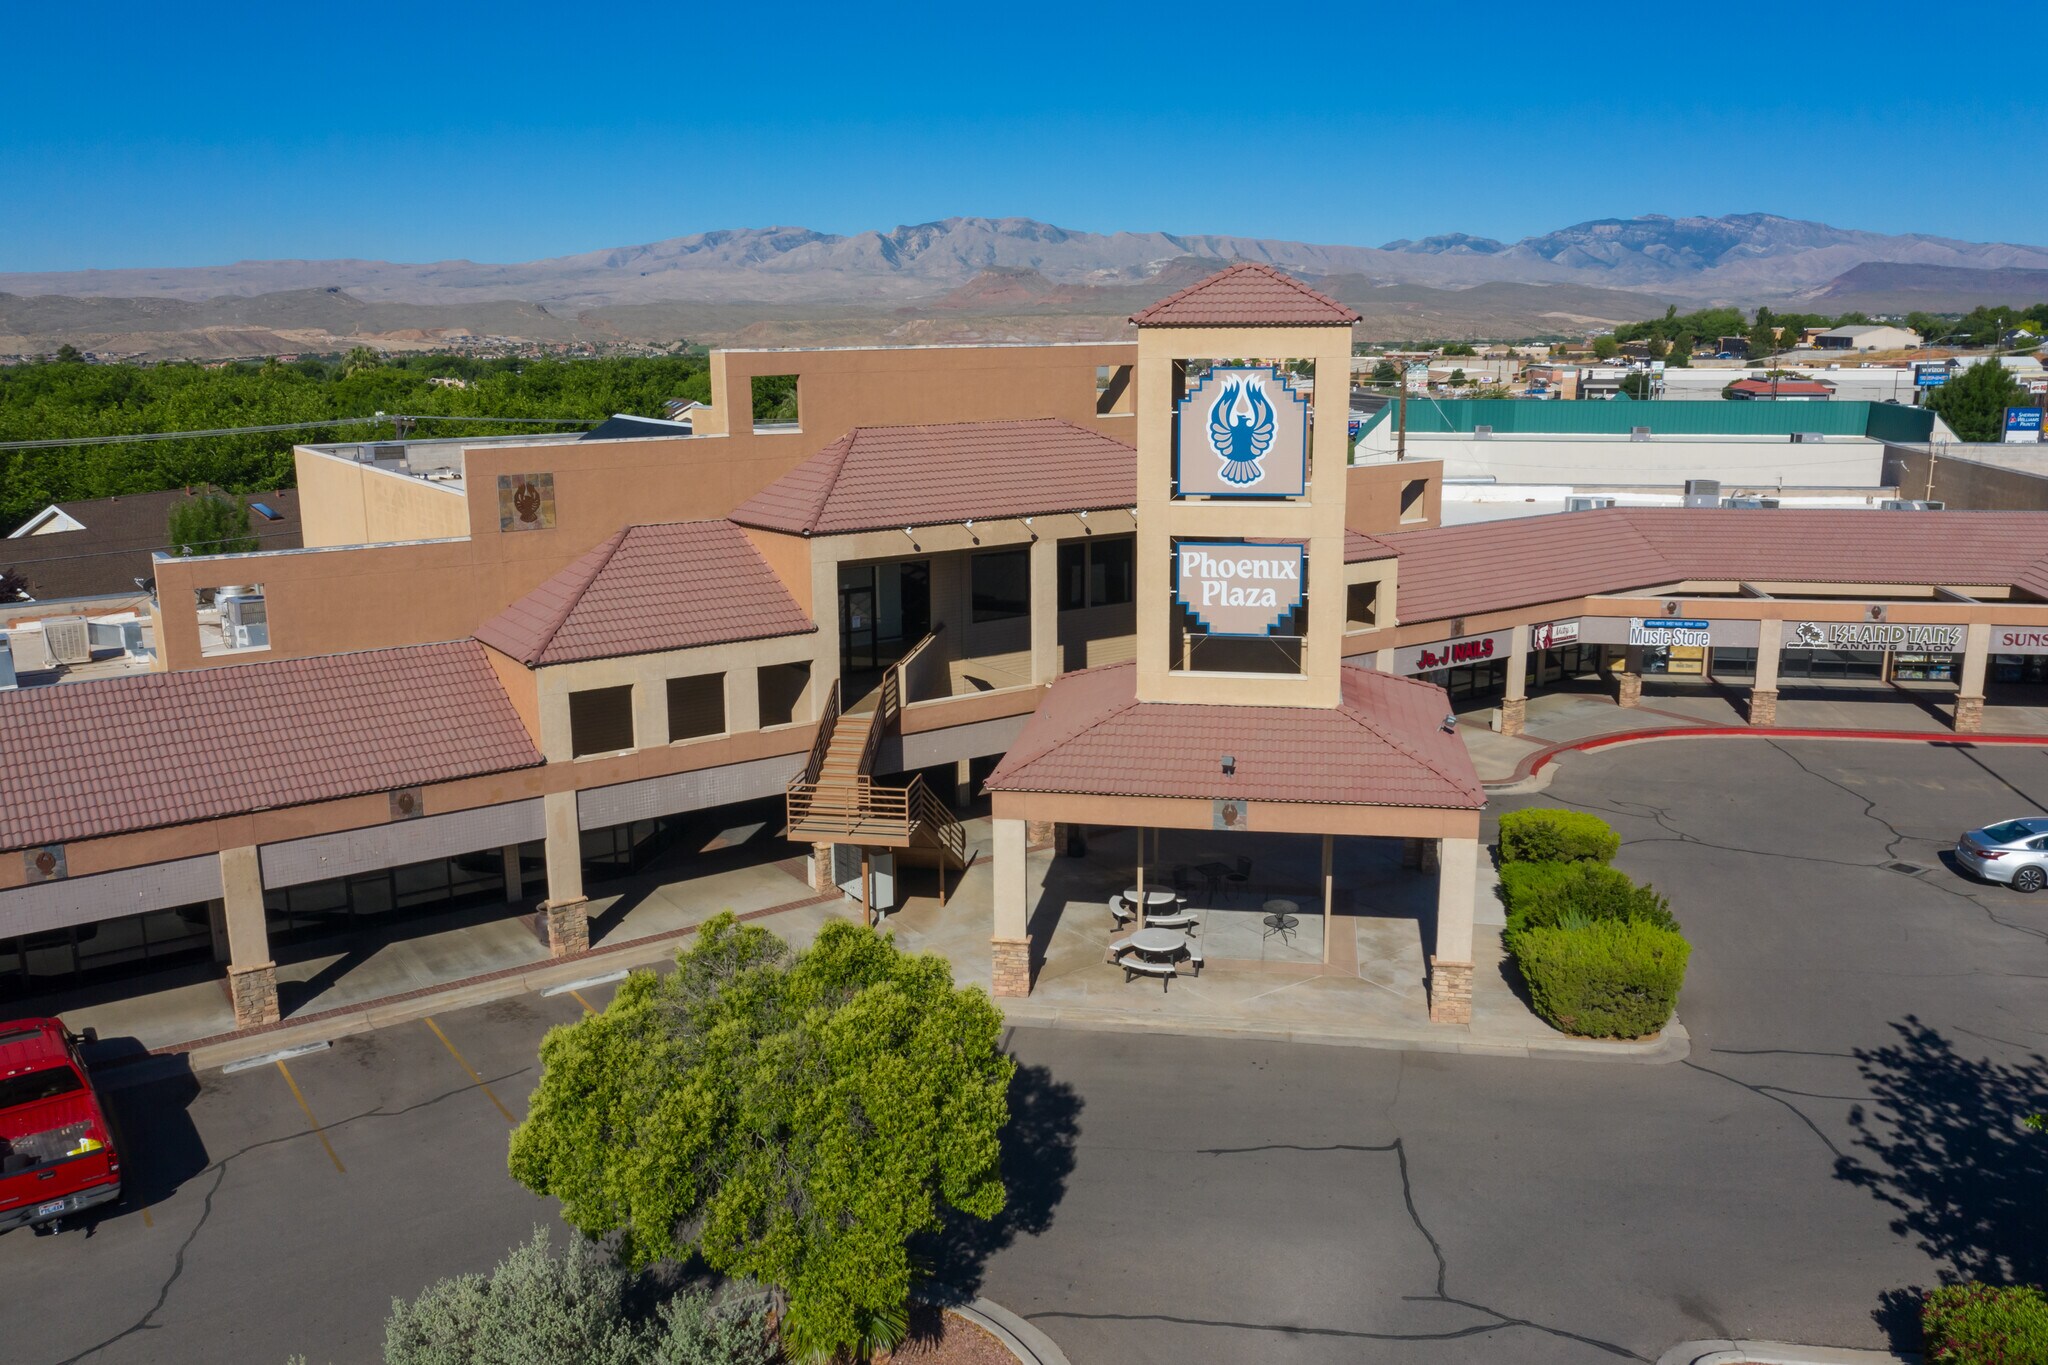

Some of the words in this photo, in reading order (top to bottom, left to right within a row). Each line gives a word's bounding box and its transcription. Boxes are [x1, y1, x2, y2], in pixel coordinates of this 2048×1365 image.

[1181, 551, 1298, 579] Phoenix
[1201, 580, 1277, 607] Plaza
[1630, 627, 1671, 645] Music
[1673, 628, 1710, 646] Store
[1829, 624, 1906, 643] ISLAND
[1907, 625, 1962, 645] TANS
[1452, 638, 1494, 663] NAILS
[1906, 644, 1953, 652] SALON
